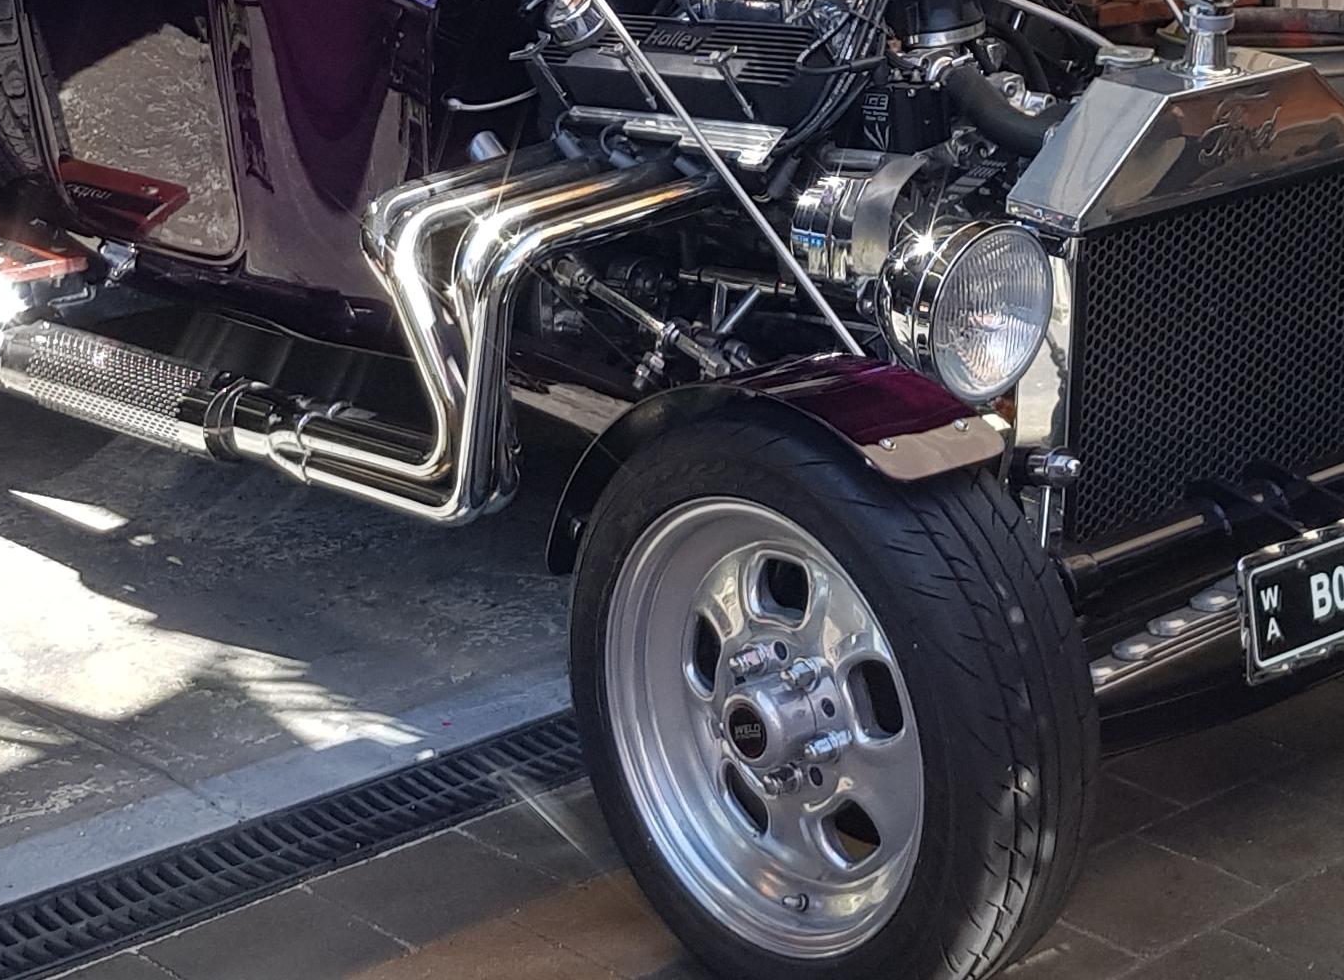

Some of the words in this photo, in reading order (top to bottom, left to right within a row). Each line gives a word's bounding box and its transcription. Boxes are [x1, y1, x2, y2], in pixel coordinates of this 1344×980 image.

[643, 28, 702, 51] Holley
[1198, 90, 1282, 170] Ford
[1260, 585, 1279, 611] W
[1266, 617, 1281, 641] A
